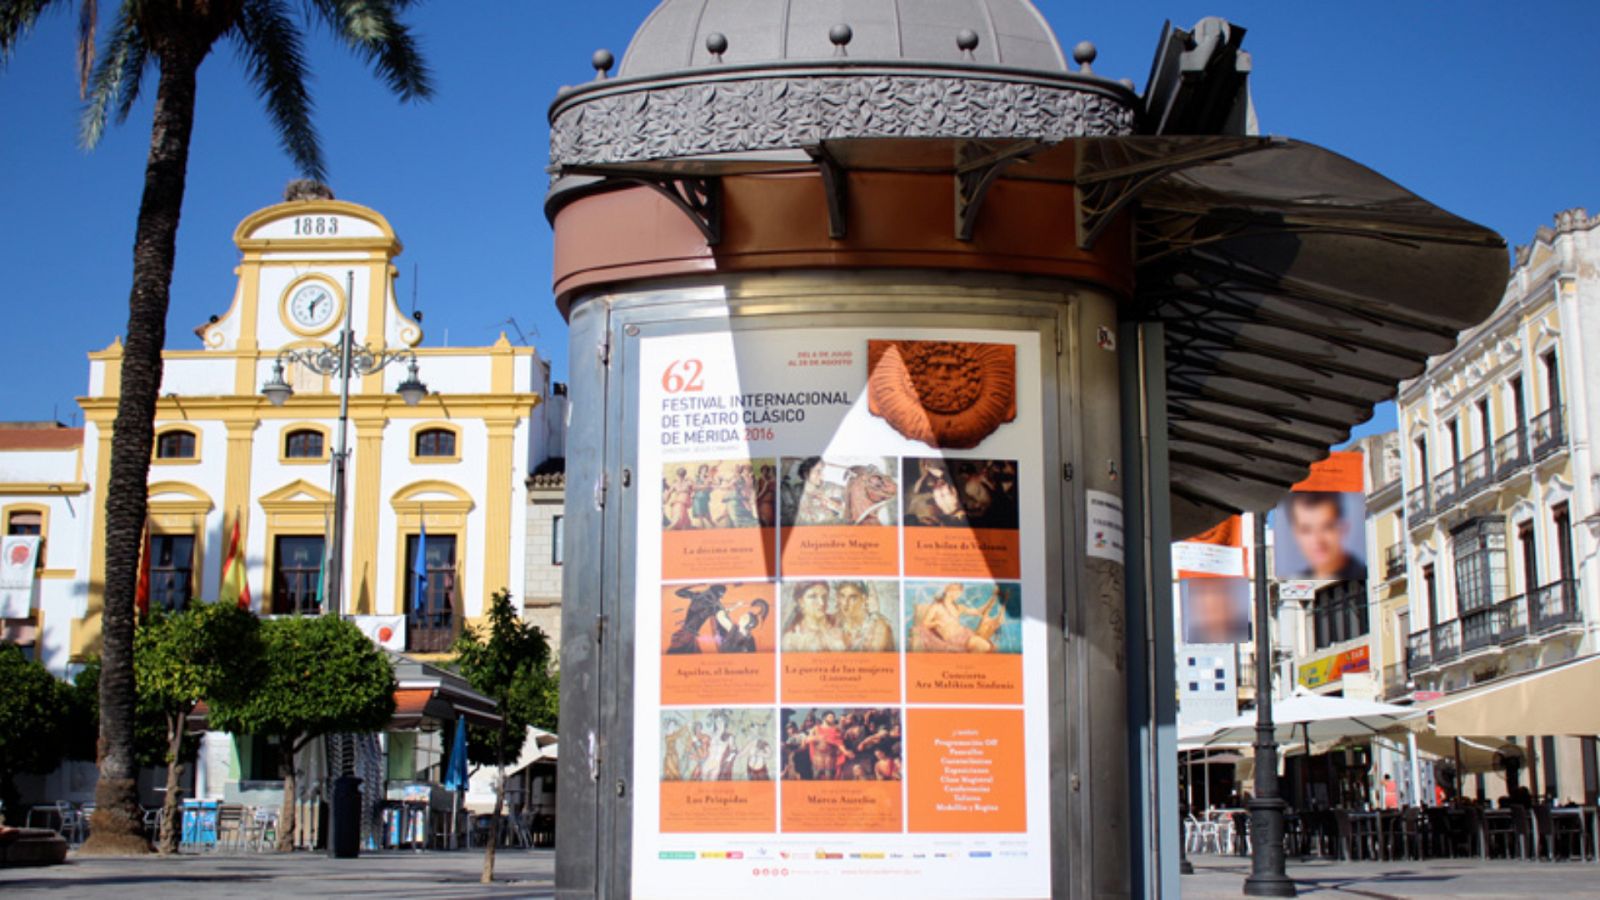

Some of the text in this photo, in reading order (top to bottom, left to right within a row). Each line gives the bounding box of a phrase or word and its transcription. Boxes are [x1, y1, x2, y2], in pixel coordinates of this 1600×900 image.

[294, 217, 338, 235] 1883
[661, 359, 704, 394] 62
[661, 391, 852, 412] FESTIVAL INTERNACIONAL
[661, 406, 806, 429] DE TEATRO CLÁSICO
[661, 427, 775, 446] DE MÉRIDA 2016
